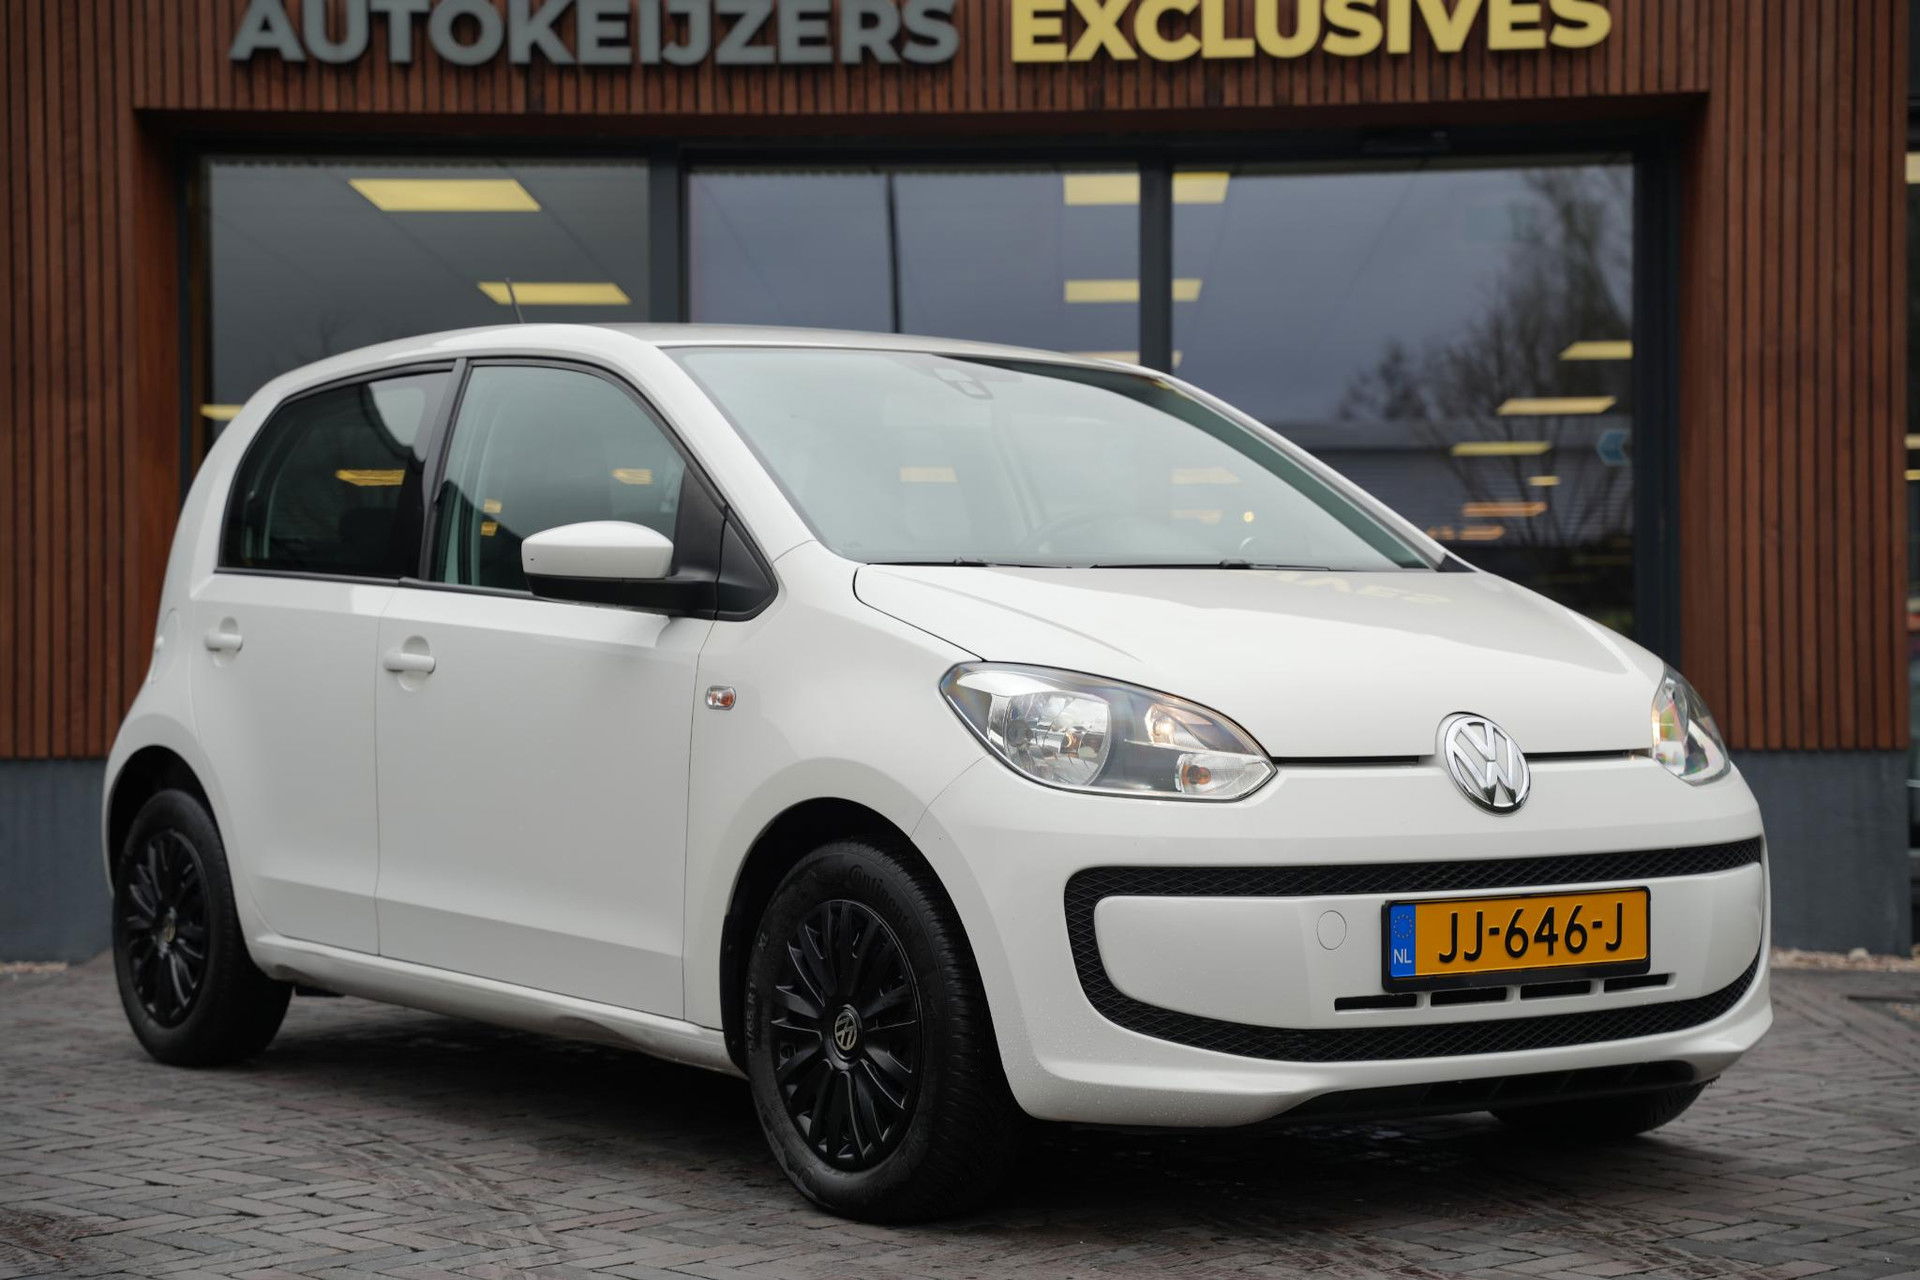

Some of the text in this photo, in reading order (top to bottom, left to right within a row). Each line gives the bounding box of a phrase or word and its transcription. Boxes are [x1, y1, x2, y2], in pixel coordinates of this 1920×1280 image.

[229, 0, 1612, 65] AUTOKEIJZERS EXCLUSIVES
[1393, 948, 1412, 964] NL
[1438, 902, 1623, 963] JJ-646-J
